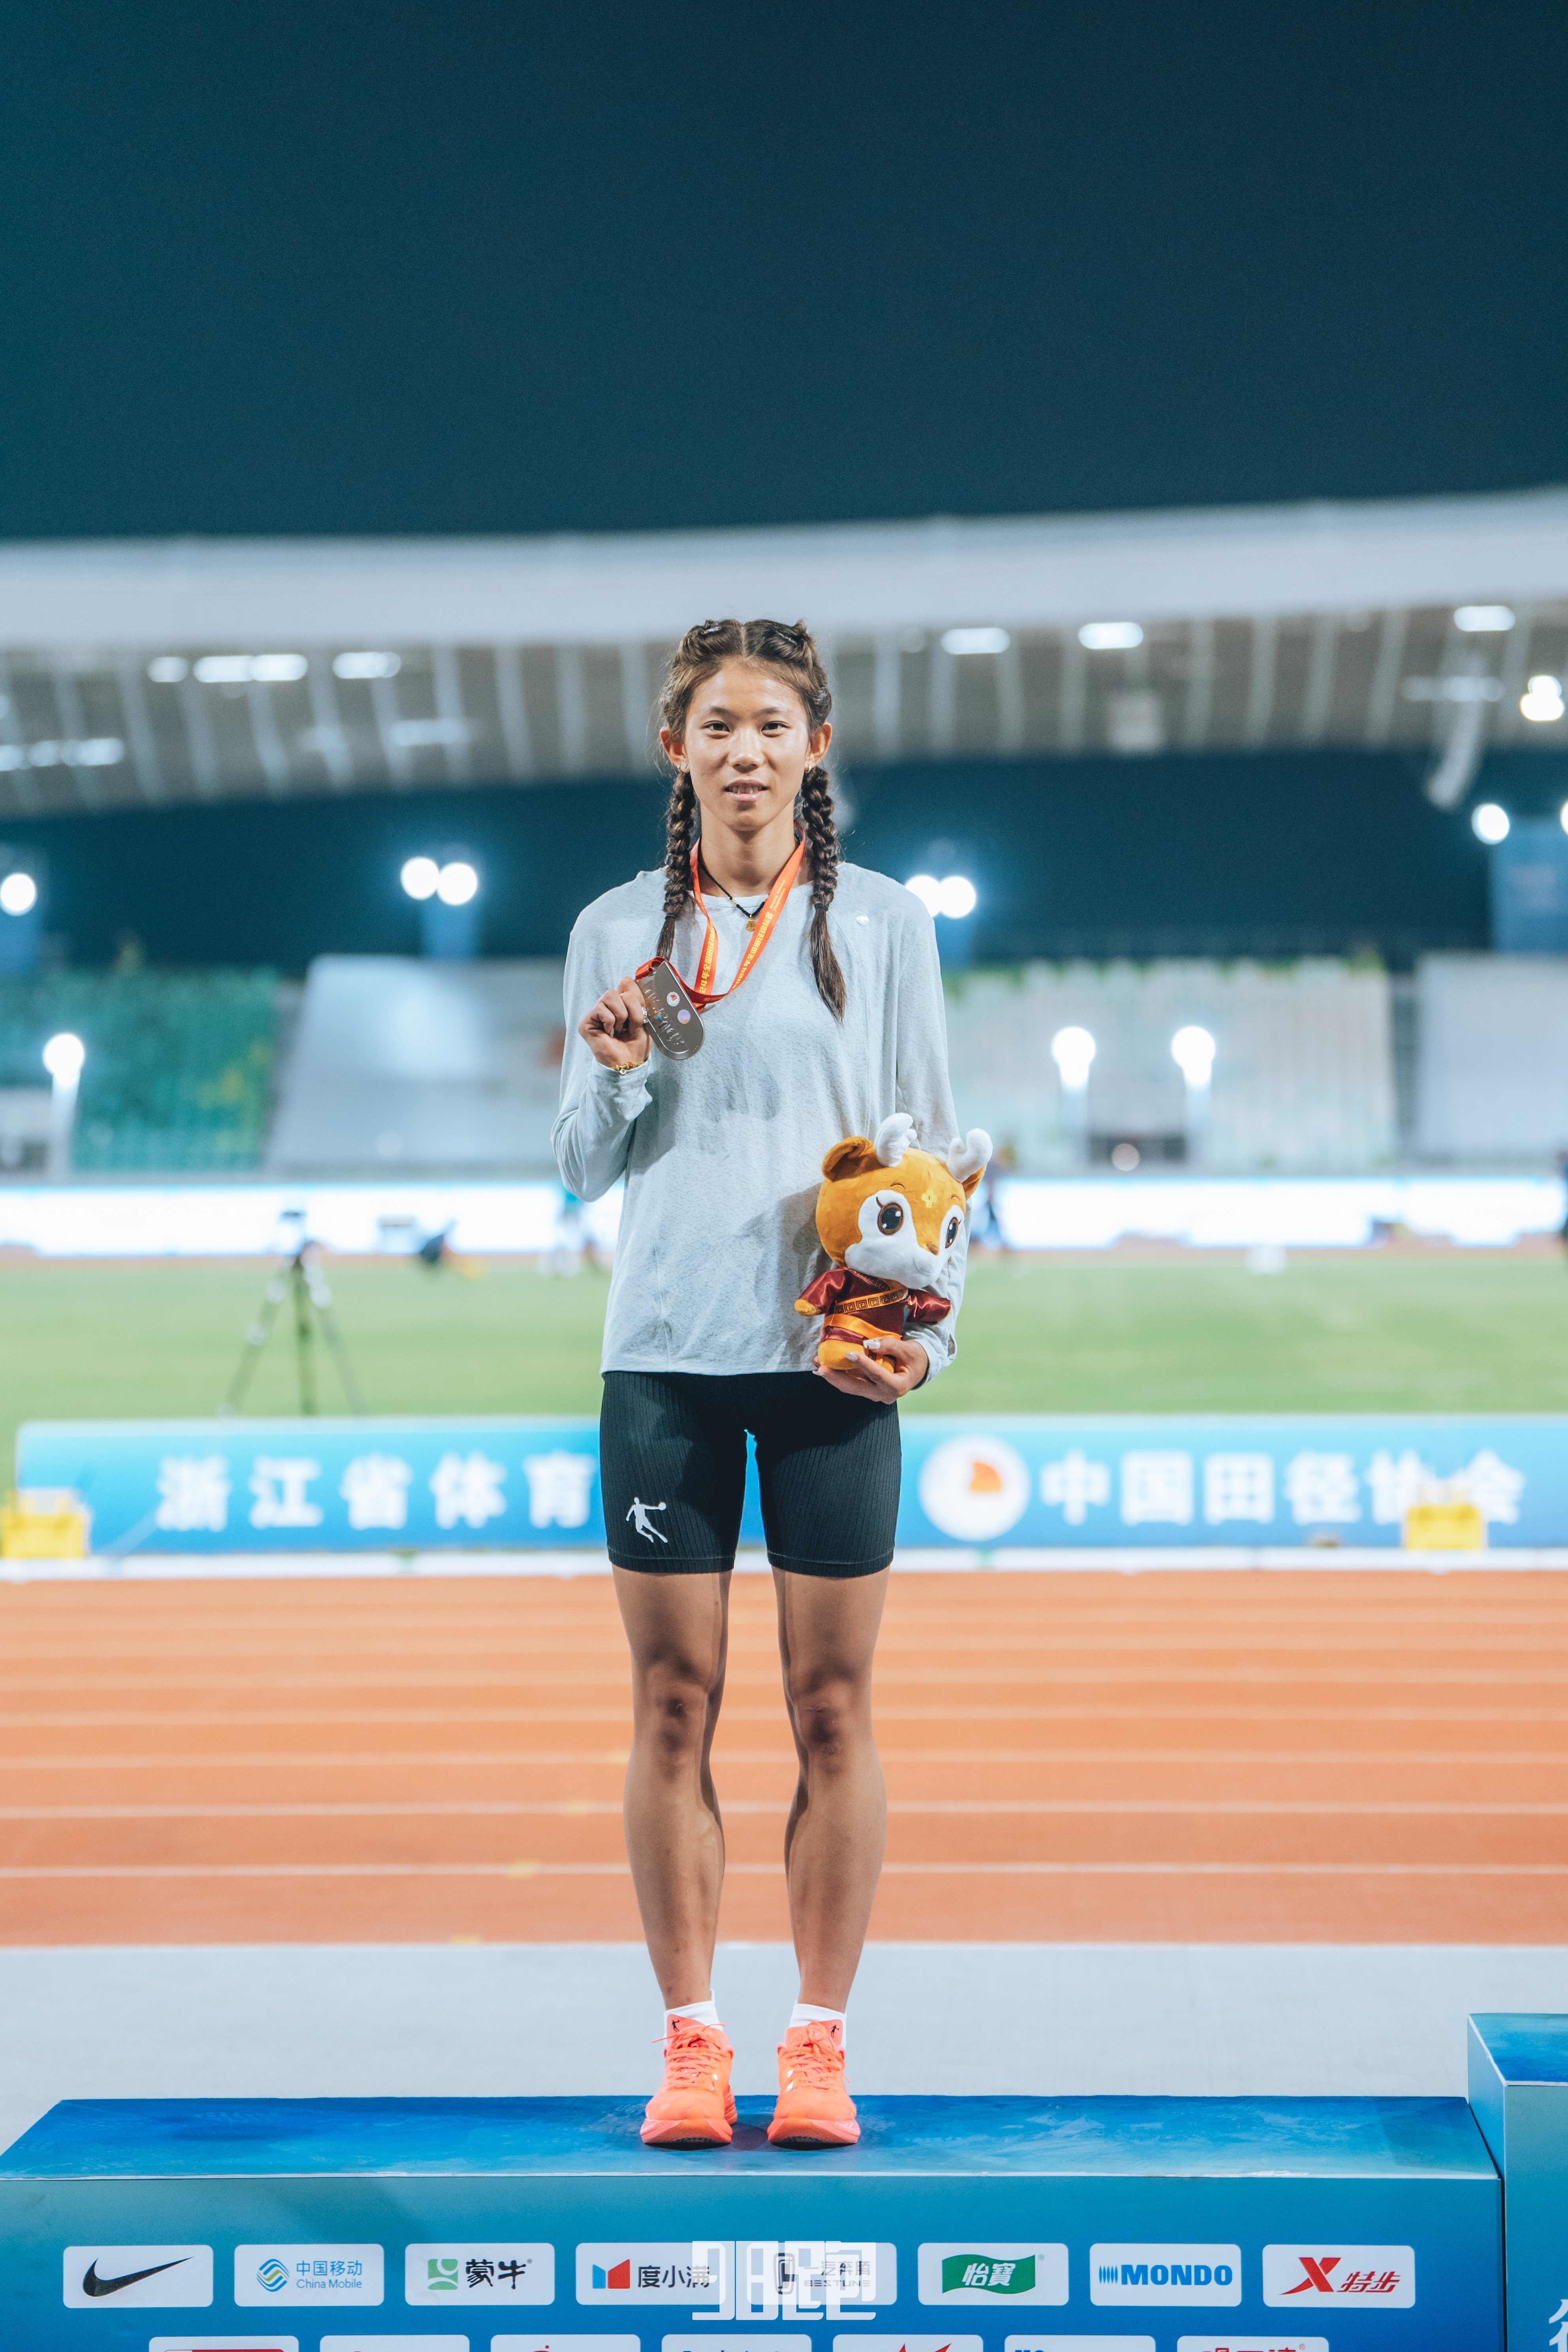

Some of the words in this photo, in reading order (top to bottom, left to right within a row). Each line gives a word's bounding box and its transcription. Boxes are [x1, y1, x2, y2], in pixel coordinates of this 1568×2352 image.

[296, 2260, 362, 2276] 中国移动
[465, 2259, 526, 2290] 蒙牛
[638, 2265, 710, 2288] 度小满
[1121, 2264, 1233, 2286] MONDO
[296, 2279, 326, 2288] China
[329, 2279, 362, 2288] Mobile
